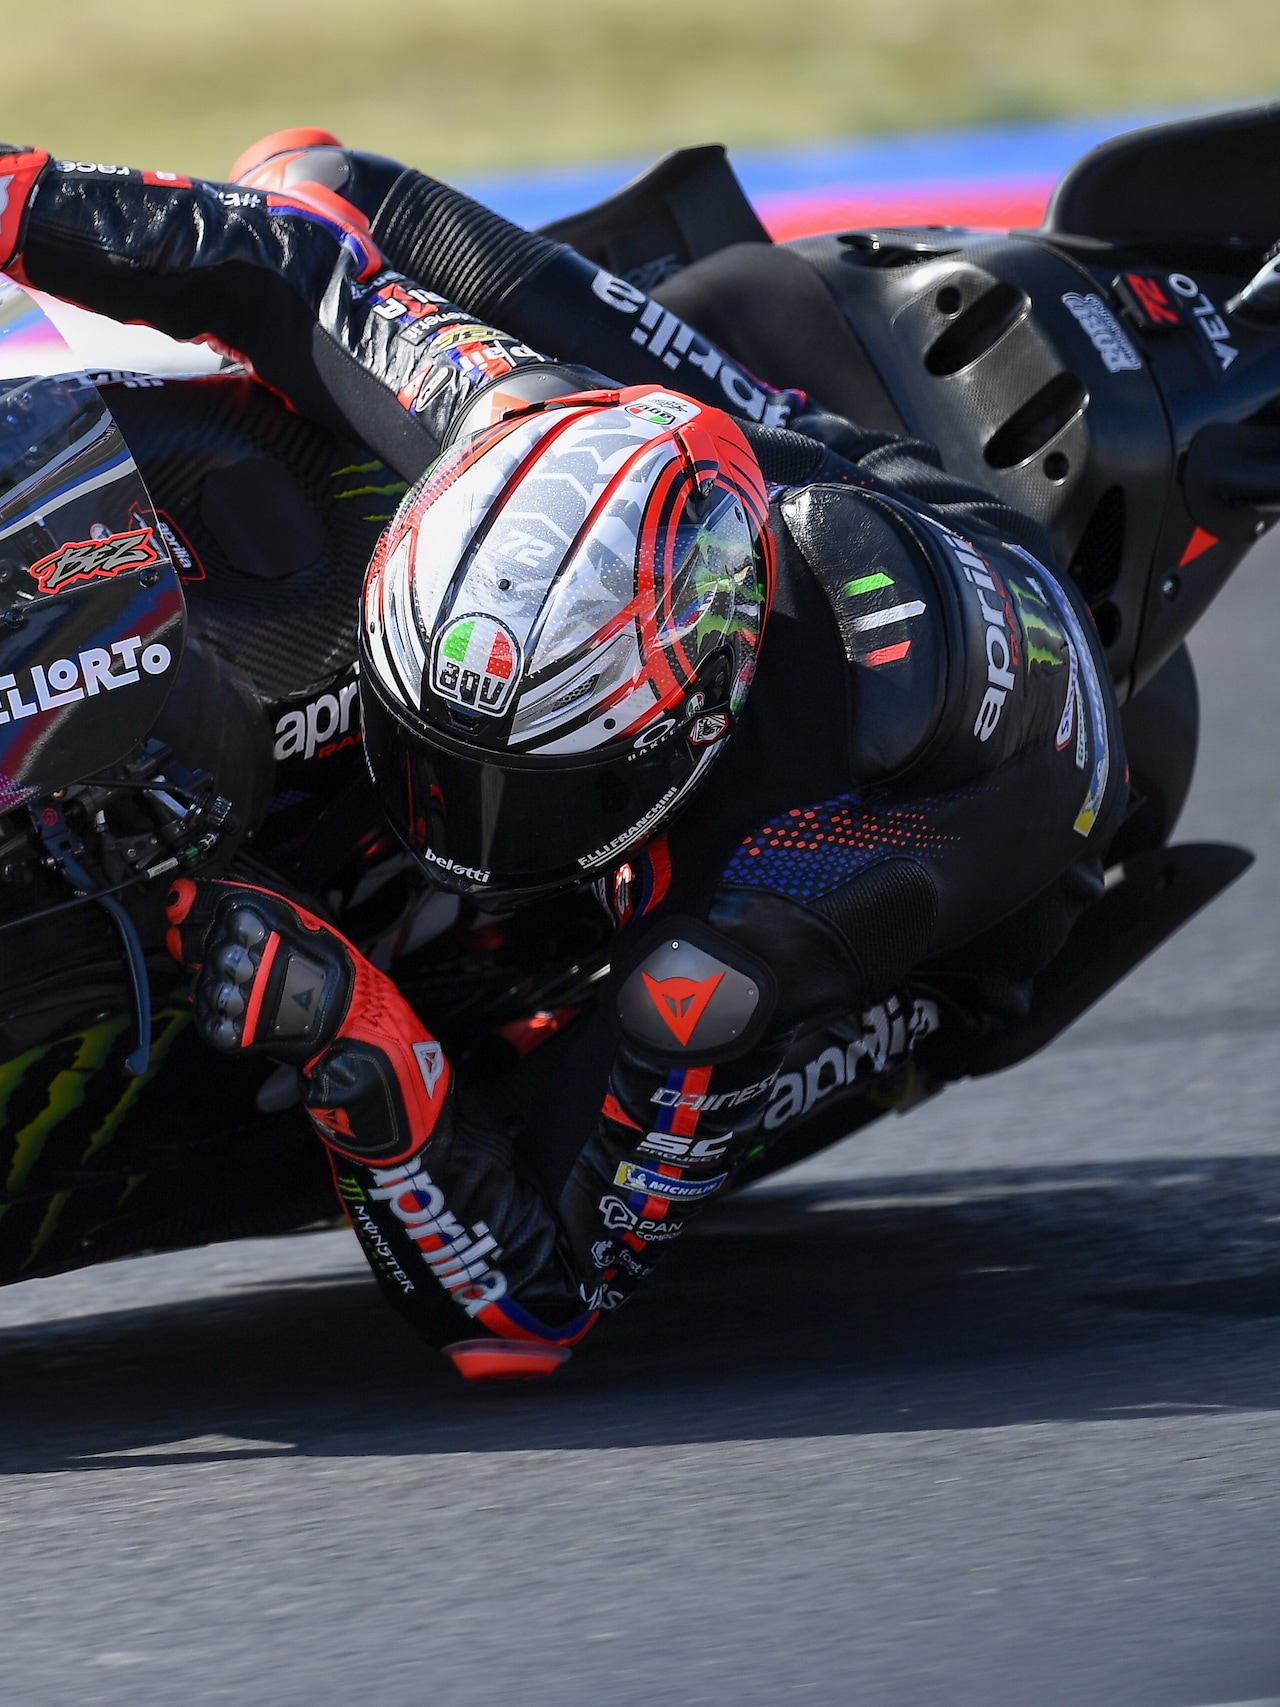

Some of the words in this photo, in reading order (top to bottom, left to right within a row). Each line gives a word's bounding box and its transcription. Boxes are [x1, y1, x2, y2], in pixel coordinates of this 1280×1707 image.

[1166, 271, 1240, 372] VELO
[35, 532, 151, 588] BEZ
[272, 658, 361, 761] apr
[609, 786, 678, 848] FRANCHINI
[424, 847, 491, 884] belotti
[639, 1130, 734, 1157] SC
[648, 1179, 719, 1198] MICHELIN
[355, 1204, 417, 1295] MONSTER
[638, 1220, 685, 1233] PAN
